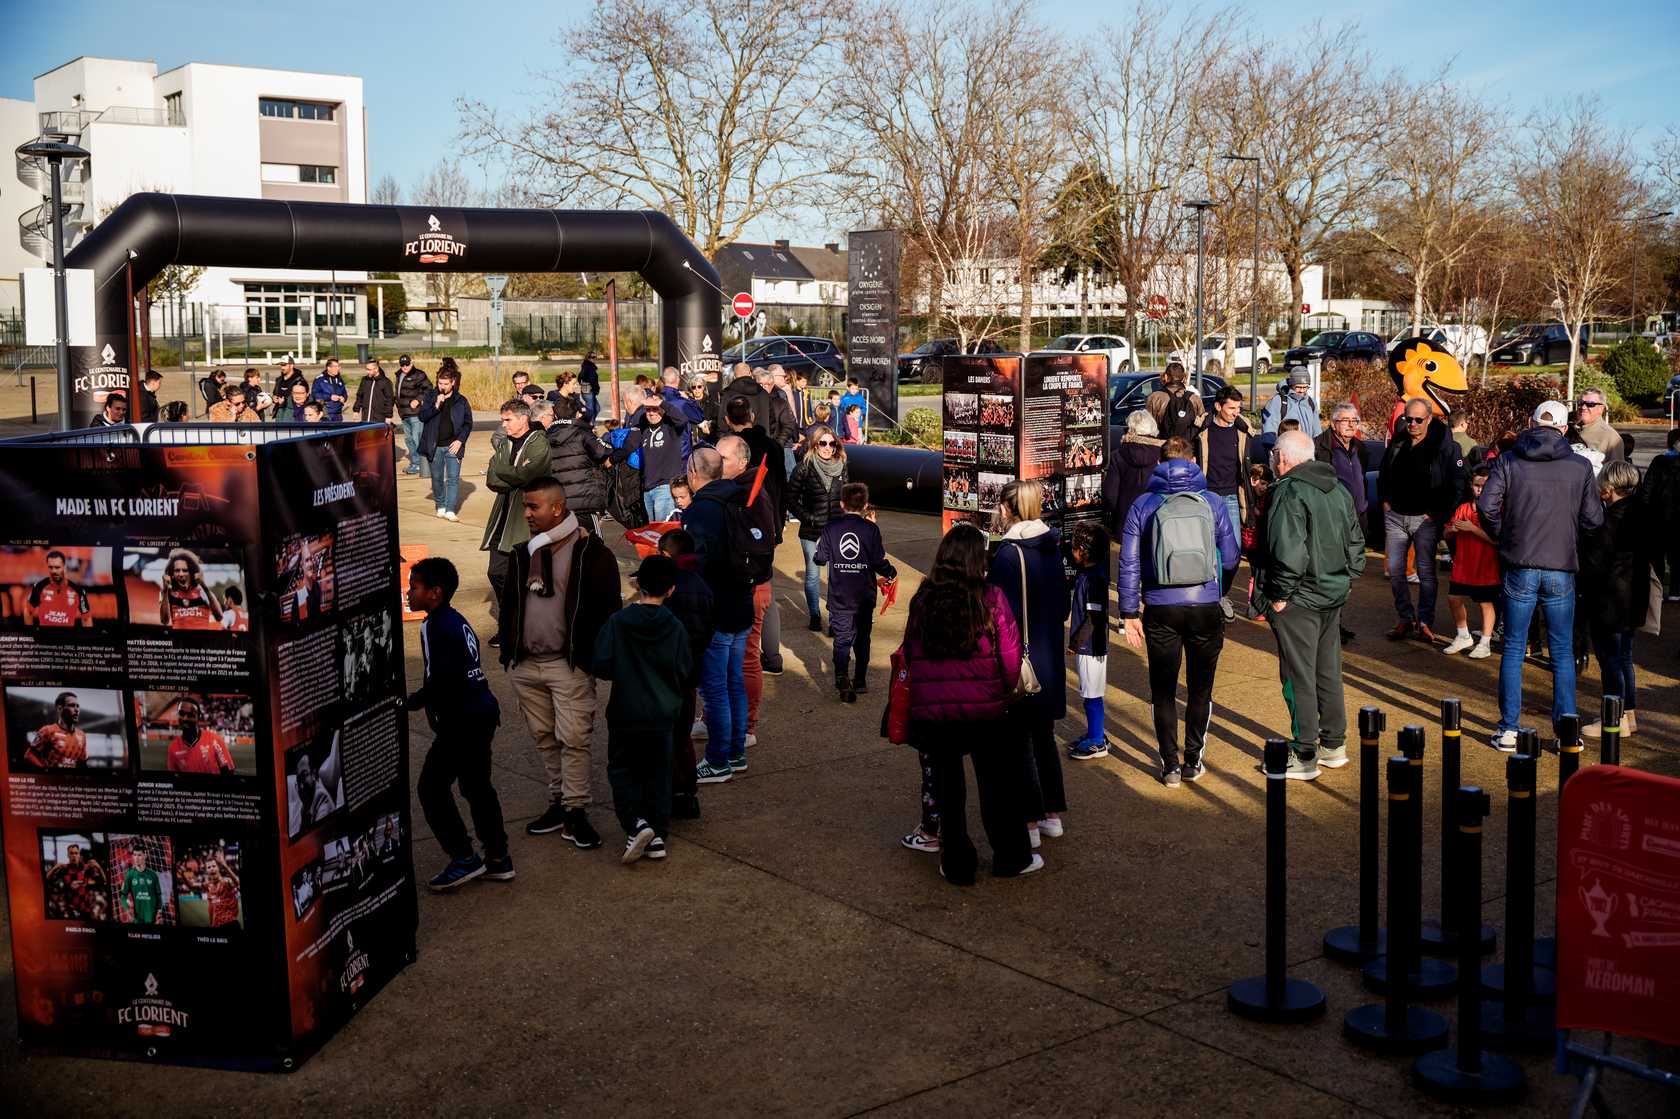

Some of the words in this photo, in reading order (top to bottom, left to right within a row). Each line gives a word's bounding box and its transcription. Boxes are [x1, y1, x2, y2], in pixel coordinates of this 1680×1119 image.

[424, 232, 446, 240] CENTENAIRE
[405, 241, 418, 256] FC
[420, 239, 467, 256] LORIENT
[870, 336, 886, 344] NORD
[680, 361, 692, 375] FC
[863, 357, 871, 365] AN
[75, 376, 88, 393] FC
[312, 488, 325, 507] LES
[324, 481, 356, 504] PRÉSIDENTS
[56, 497, 91, 516] MADE
[94, 498, 108, 516] IN
[110, 498, 126, 516] FC
[128, 498, 179, 517] LORIENT
[346, 953, 370, 982] LORIENT
[1584, 969, 1656, 998] KEROMAN
[118, 1006, 133, 1025] FC
[134, 1005, 190, 1028] LORIENT
